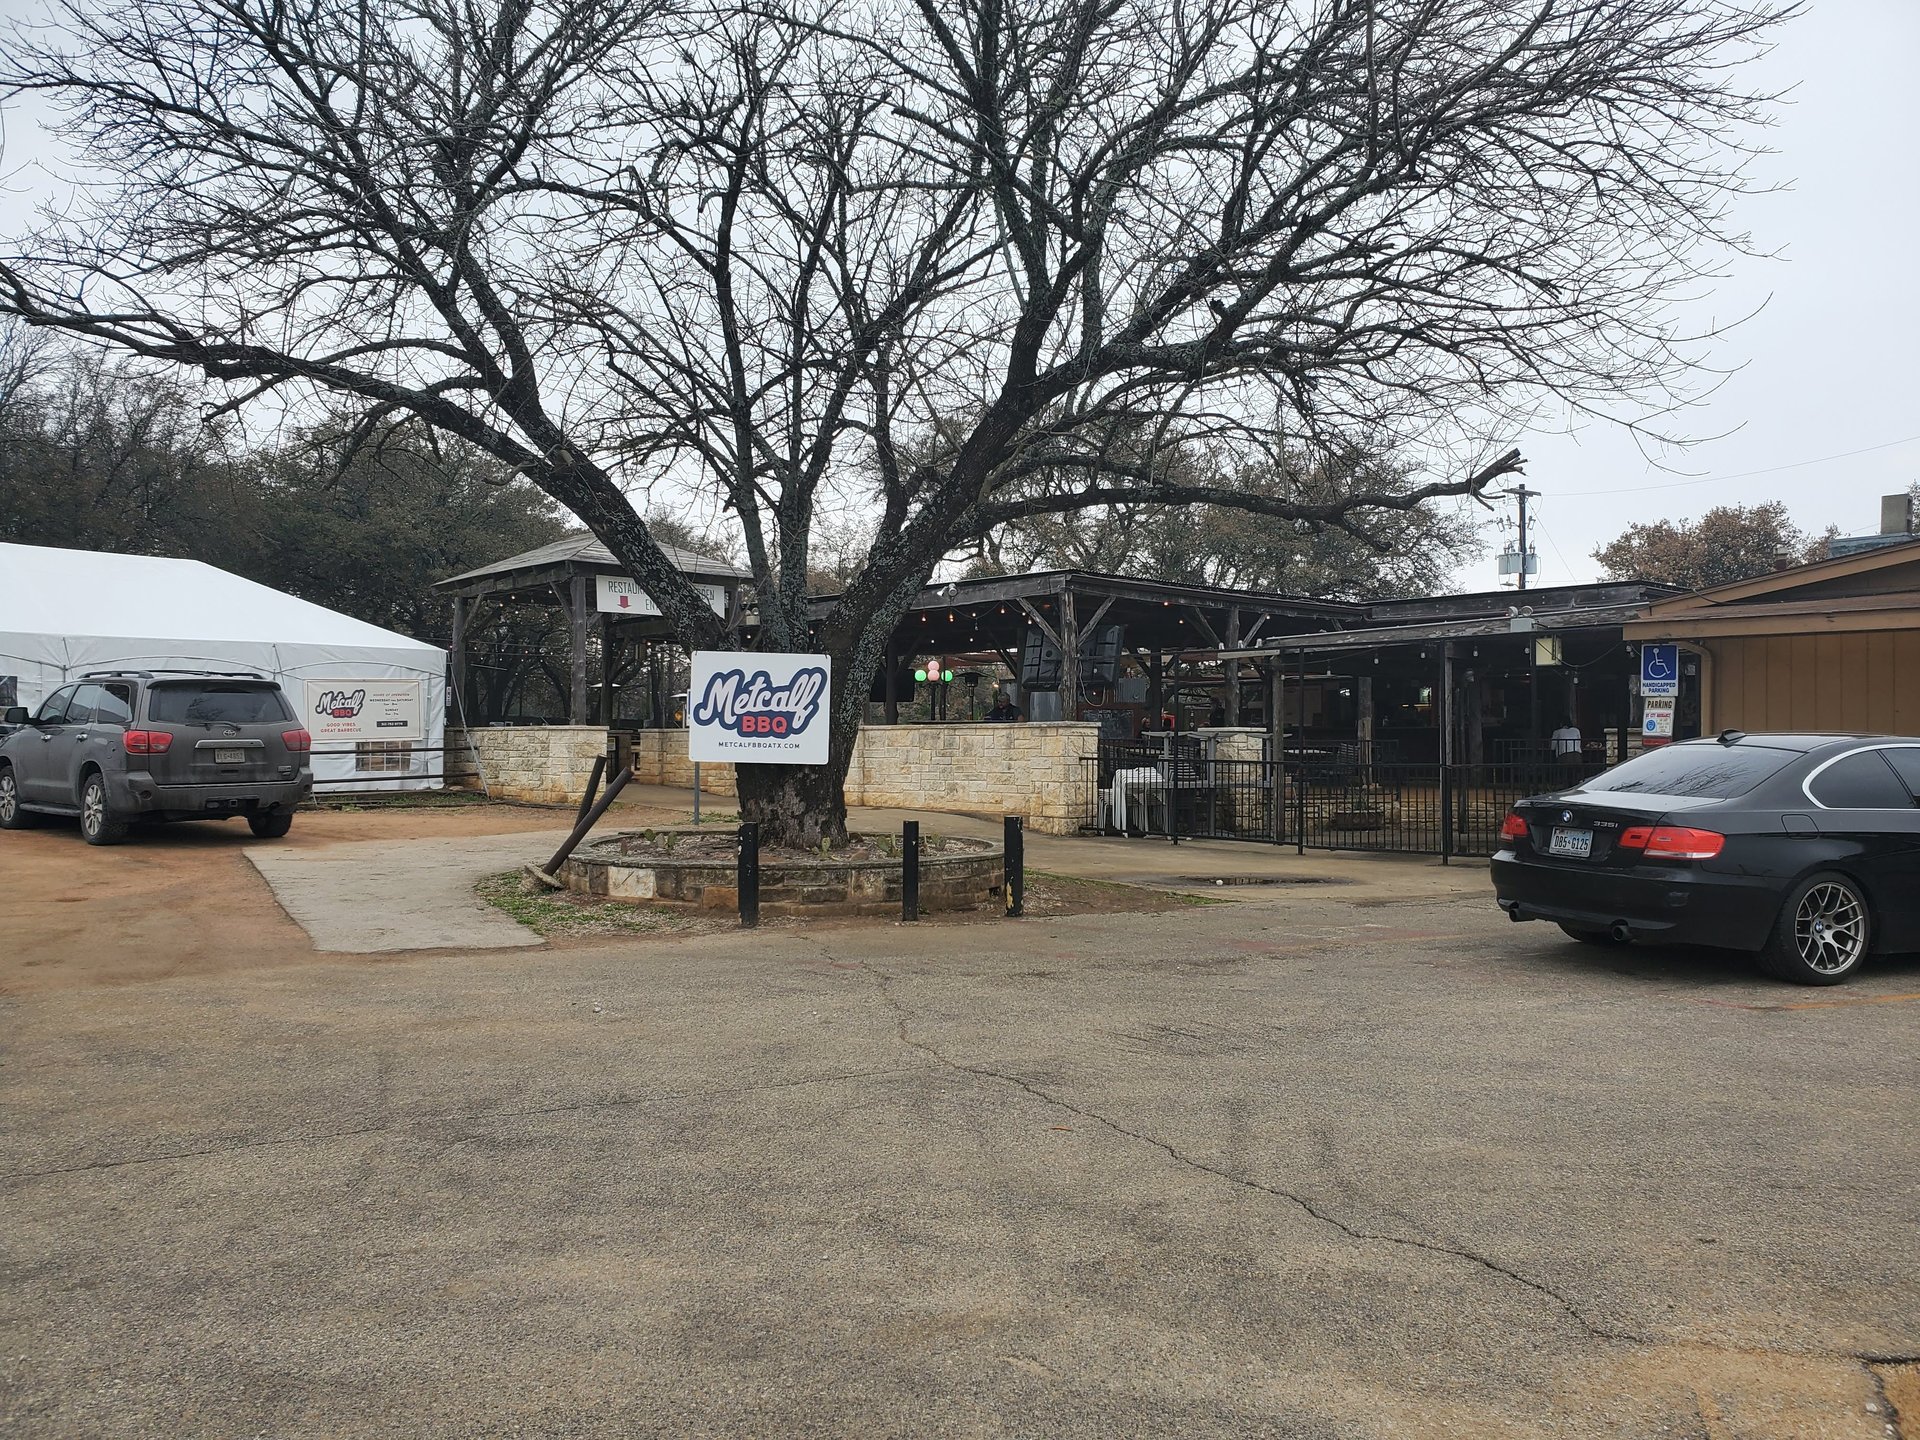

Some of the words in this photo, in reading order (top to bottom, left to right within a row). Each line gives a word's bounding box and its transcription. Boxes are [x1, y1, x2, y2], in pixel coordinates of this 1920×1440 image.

[608, 580, 643, 594] RESTAUR
[316, 690, 364, 715] Metcalf
[698, 671, 823, 731] Metcalf
[1647, 700, 1672, 709] PARKING
[334, 709, 352, 717] BBQ
[742, 715, 788, 734] BBQ
[718, 741, 800, 749] METCALFBBQATX.COM
